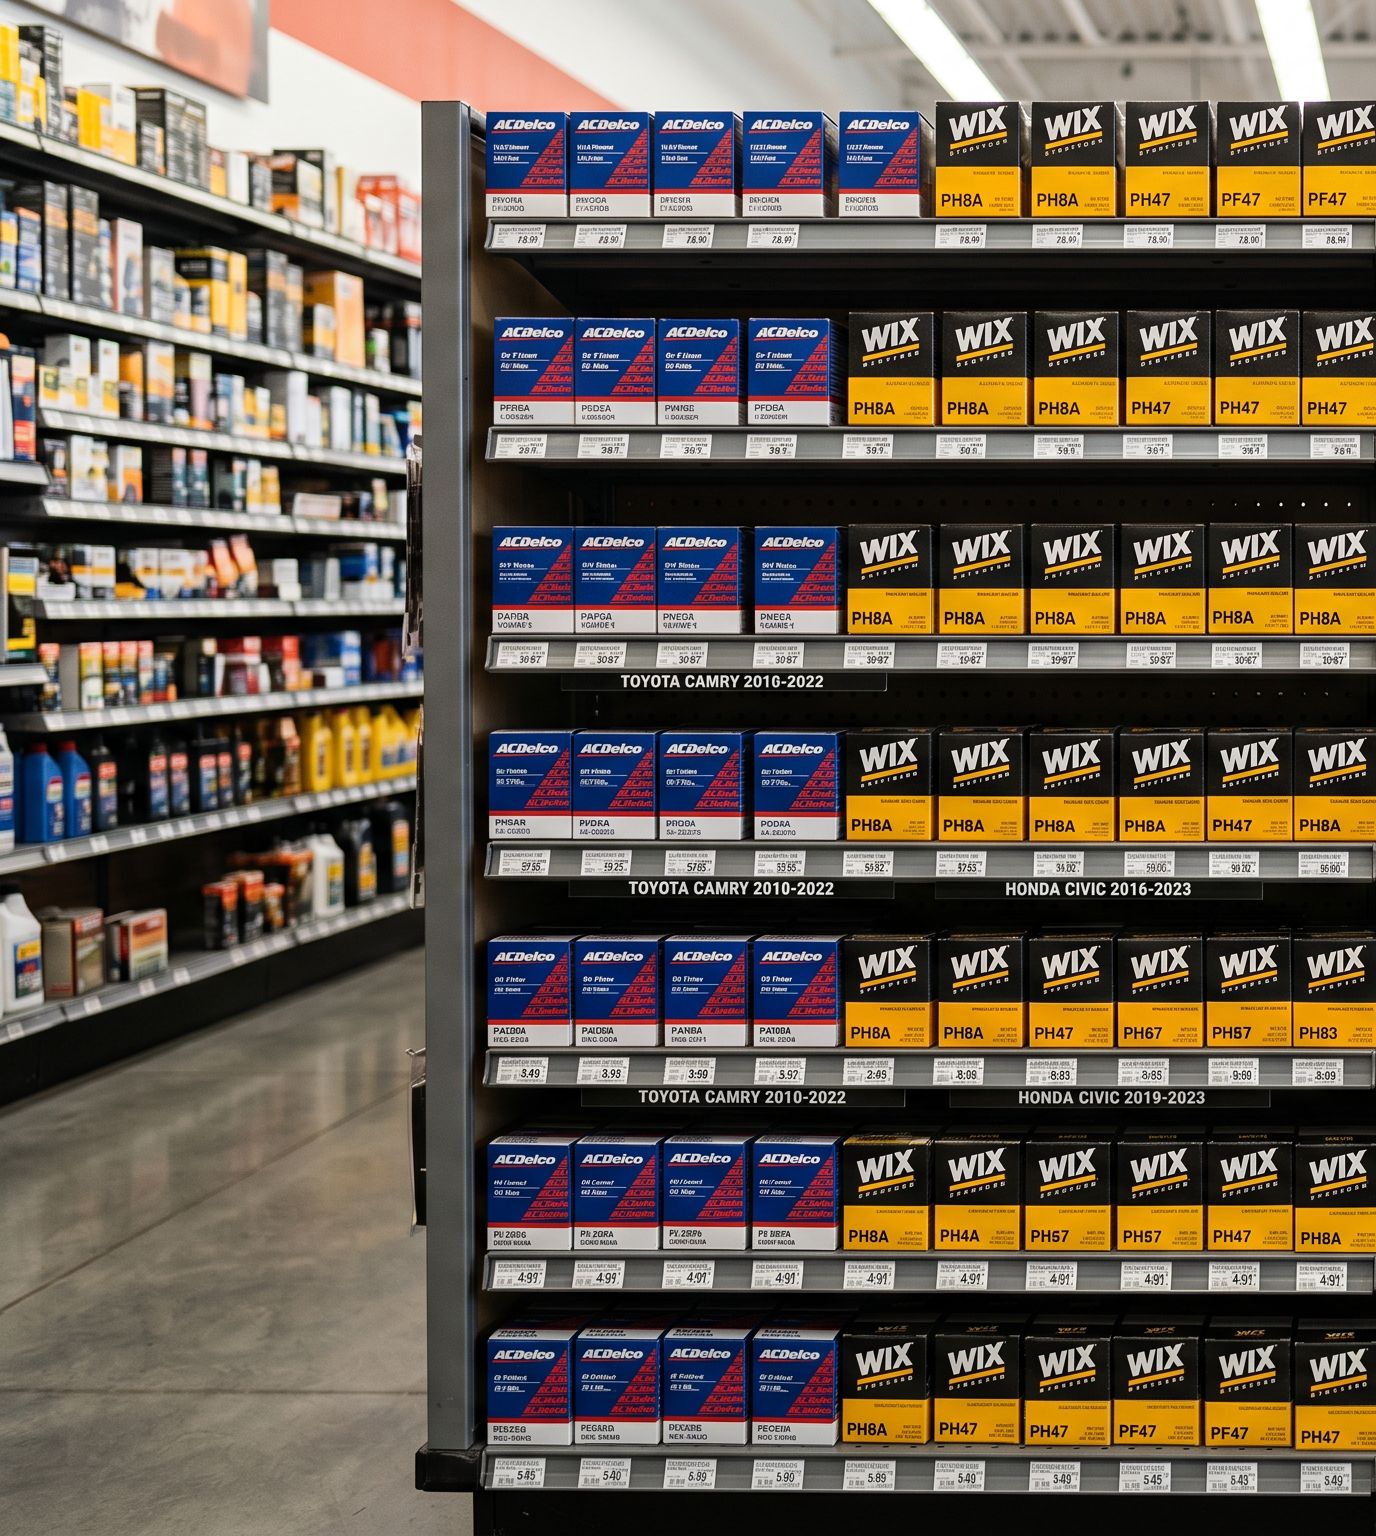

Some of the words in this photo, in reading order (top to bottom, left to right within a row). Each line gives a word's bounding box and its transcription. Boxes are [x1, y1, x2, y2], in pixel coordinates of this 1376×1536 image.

[493, 119, 556, 130] ACDelco
[661, 119, 725, 130] ACDelco
[846, 119, 910, 130] ACDelco
[948, 105, 1007, 141] WIX
[1138, 105, 1197, 141] WIX
[1316, 104, 1375, 141] WIX
[941, 193, 983, 207] PH8A
[1222, 192, 1261, 206] PF47
[501, 327, 564, 338] ACDelco
[755, 326, 819, 338] ACDelco
[861, 316, 920, 353] WIX
[1046, 316, 1106, 353] WIX
[1315, 316, 1375, 352] WIX
[1039, 401, 1081, 415] PH8A
[1307, 401, 1347, 415] PH47
[499, 536, 563, 548] ACDelco
[664, 536, 728, 548] ACDelco
[859, 529, 918, 565] WIX
[1042, 529, 1102, 565] WIX
[1307, 529, 1367, 565] WIX
[852, 611, 893, 625] PH8A
[1300, 611, 1341, 625] PH8A
[620, 674, 681, 688] TOYOTA
[684, 674, 740, 688] CAMRY
[496, 742, 559, 754] ACDelco
[761, 743, 824, 755] ACDelco
[859, 737, 919, 773] WIX
[1041, 739, 1101, 775] WIX
[1307, 738, 1367, 773] WIX
[943, 819, 985, 832] PH8A
[1212, 819, 1252, 832] PH47
[628, 880, 690, 895] TOYOTA
[693, 880, 750, 895] CAMRY
[753, 881, 835, 896] 2010-2022
[1005, 881, 1061, 896] HONDA
[1064, 881, 1107, 896] CIVIC
[1110, 881, 1192, 896] 2016-2023
[494, 951, 556, 962] ACDelco
[761, 951, 823, 962] ACDelco
[858, 945, 917, 979] WIX
[1041, 945, 1100, 980] WIX
[1306, 945, 1365, 979] WIX
[1035, 1027, 1074, 1040] PH47
[1299, 1026, 1338, 1040] PH83
[638, 1089, 700, 1104] TOYOTA
[705, 1089, 761, 1104] CAMRY
[764, 1090, 847, 1104] 2010-2022
[1018, 1090, 1074, 1105] HONDA
[1078, 1090, 1120, 1105] CIVIC
[1124, 1090, 1206, 1105] 2019-2023
[494, 1154, 556, 1165] ACDelco
[669, 1152, 732, 1164] ACDelco
[1038, 1147, 1096, 1183] WIX
[856, 1148, 914, 1184] WIX
[1308, 1149, 1367, 1185] WIX
[848, 1229, 889, 1243] PH8A
[1031, 1229, 1069, 1243] PH57
[493, 1349, 555, 1360] ACDelco
[759, 1349, 820, 1360] ACDelco
[855, 1342, 914, 1376] WIX
[1038, 1343, 1096, 1378] WIX
[1309, 1348, 1367, 1381] WIX
[939, 1422, 978, 1435] PH47
[1211, 1426, 1249, 1440] PF47
